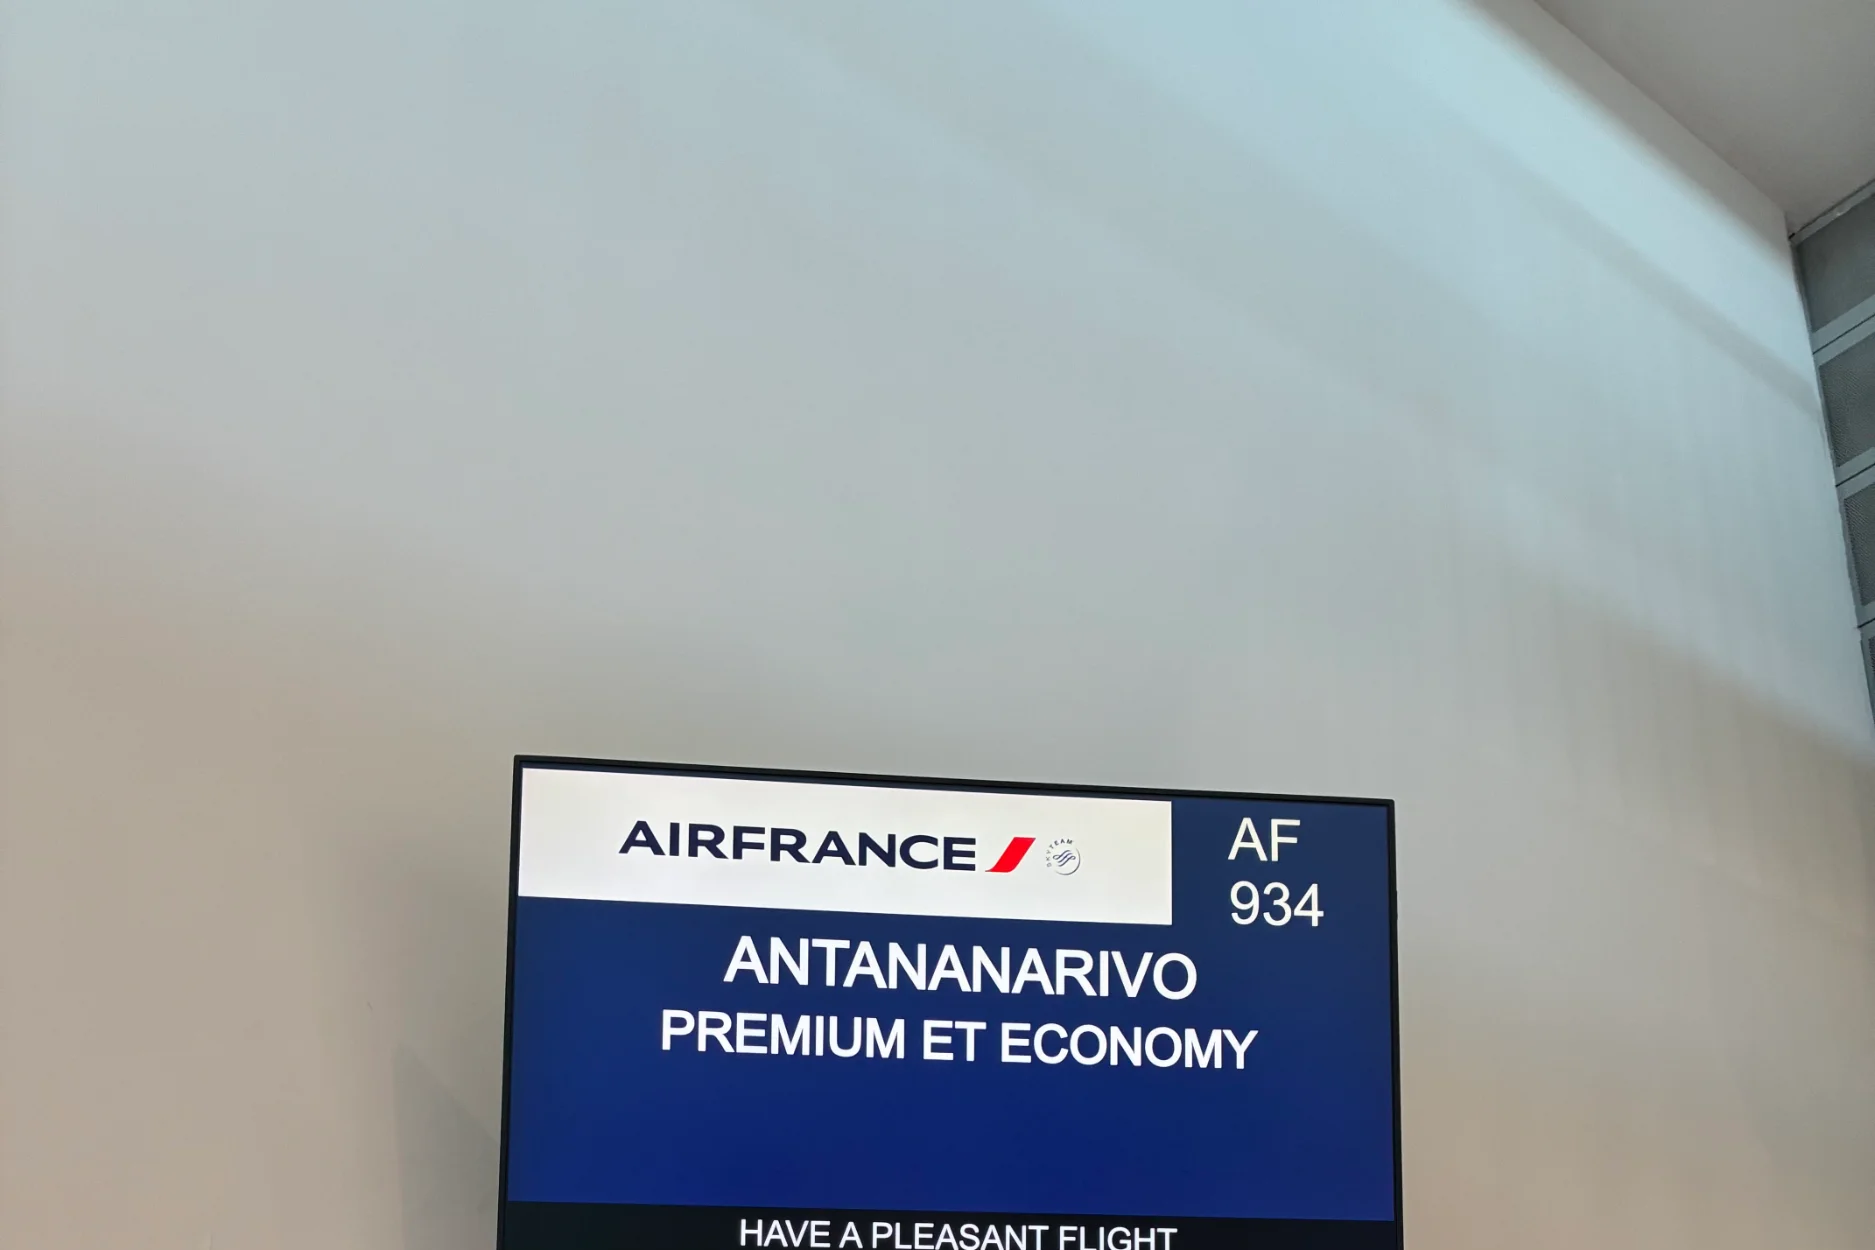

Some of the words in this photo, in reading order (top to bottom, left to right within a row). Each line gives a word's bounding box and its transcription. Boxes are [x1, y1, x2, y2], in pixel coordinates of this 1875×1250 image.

[618, 820, 976, 872] AIRFRANCE
[1227, 817, 1301, 862] AF
[1230, 880, 1325, 927] 934
[723, 935, 1197, 1000] ANTANANARIVO
[662, 1009, 905, 1059] PREMIUM
[923, 1019, 987, 1062] ET
[1001, 1022, 1259, 1070] ECONOMY
[740, 1218, 831, 1248] HAVE
[838, 1221, 864, 1249] A
